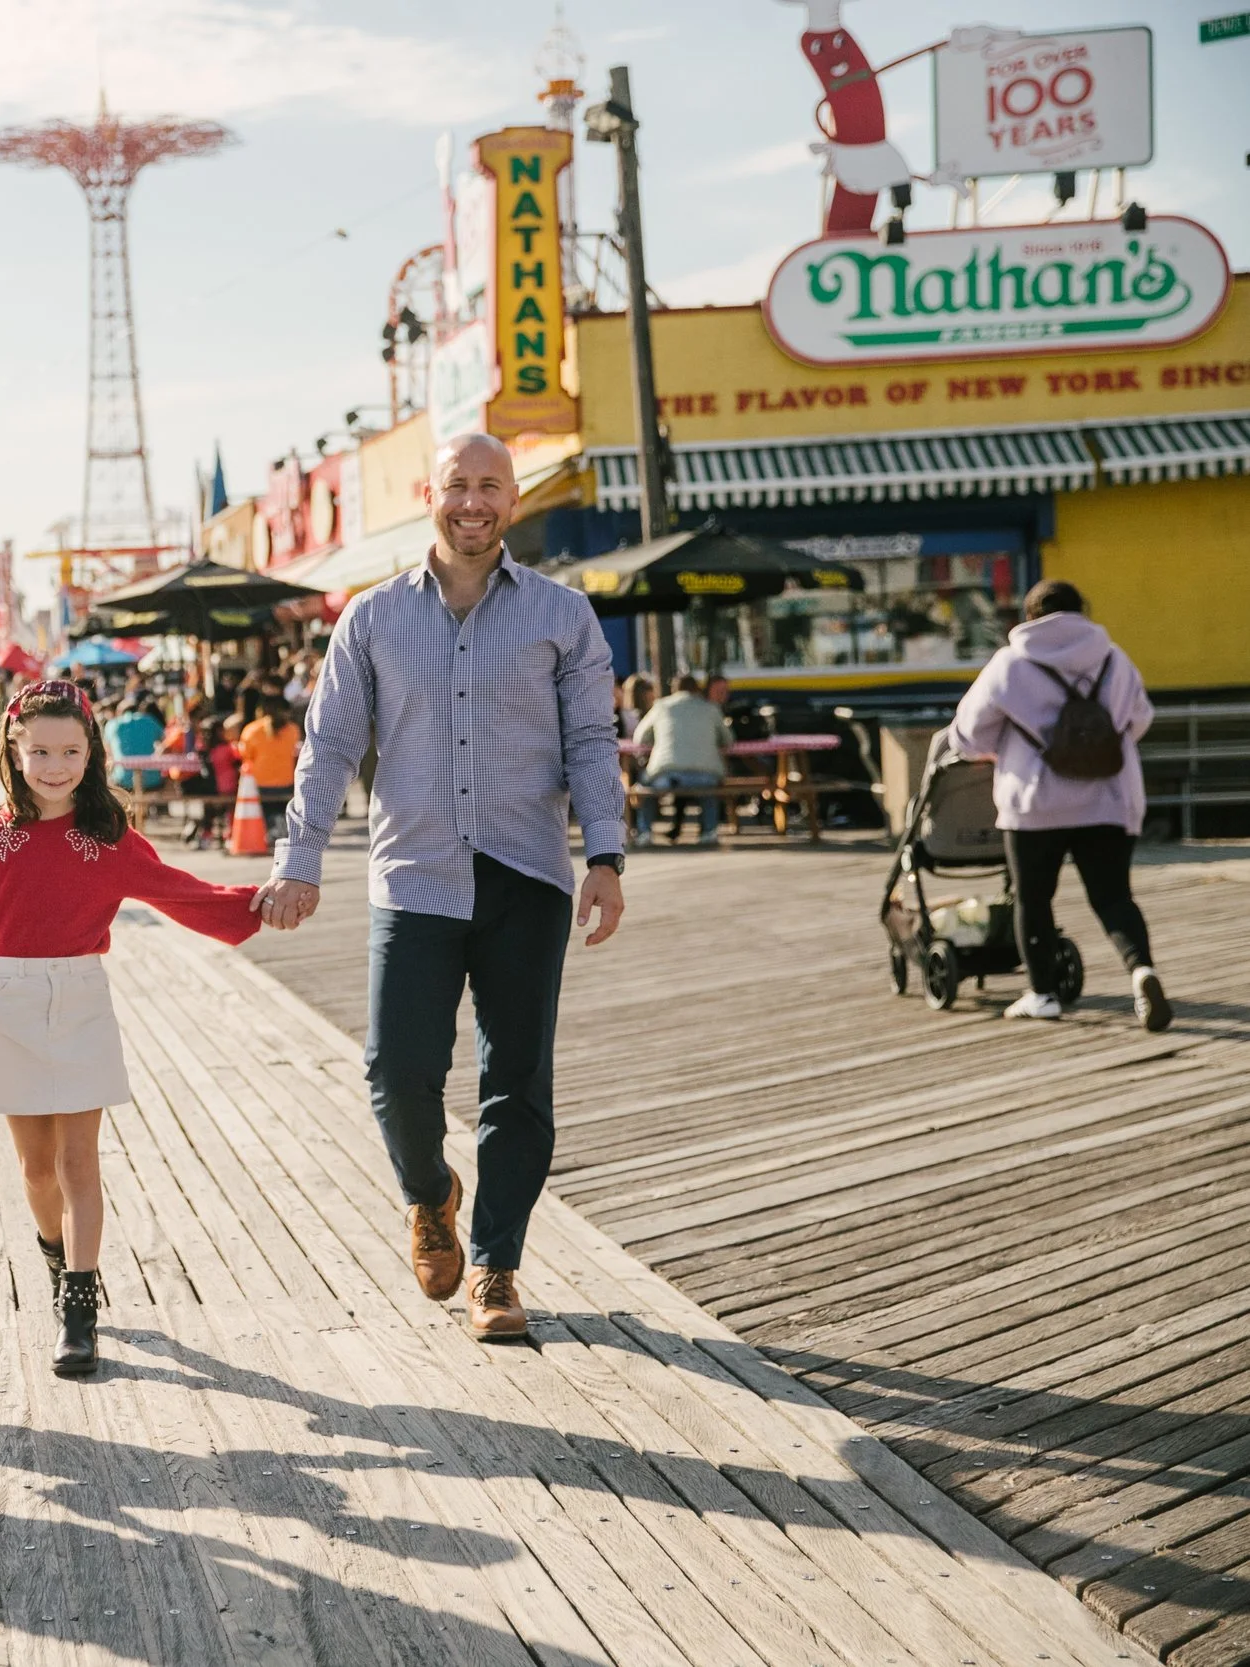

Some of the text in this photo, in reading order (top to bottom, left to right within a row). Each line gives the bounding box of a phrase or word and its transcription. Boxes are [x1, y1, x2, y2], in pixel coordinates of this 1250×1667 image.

[987, 44, 1088, 77] FOR OVER
[987, 66, 1093, 124] 100
[988, 111, 1096, 151] YEARS
[510, 155, 547, 395] NATHANS
[806, 239, 1191, 320] Nathan's
[736, 384, 867, 413] FLAVOR
[885, 379, 930, 404] OF
[948, 373, 1025, 399] NEW
[1046, 366, 1142, 395] YORK
[1160, 360, 1250, 388] SINC
